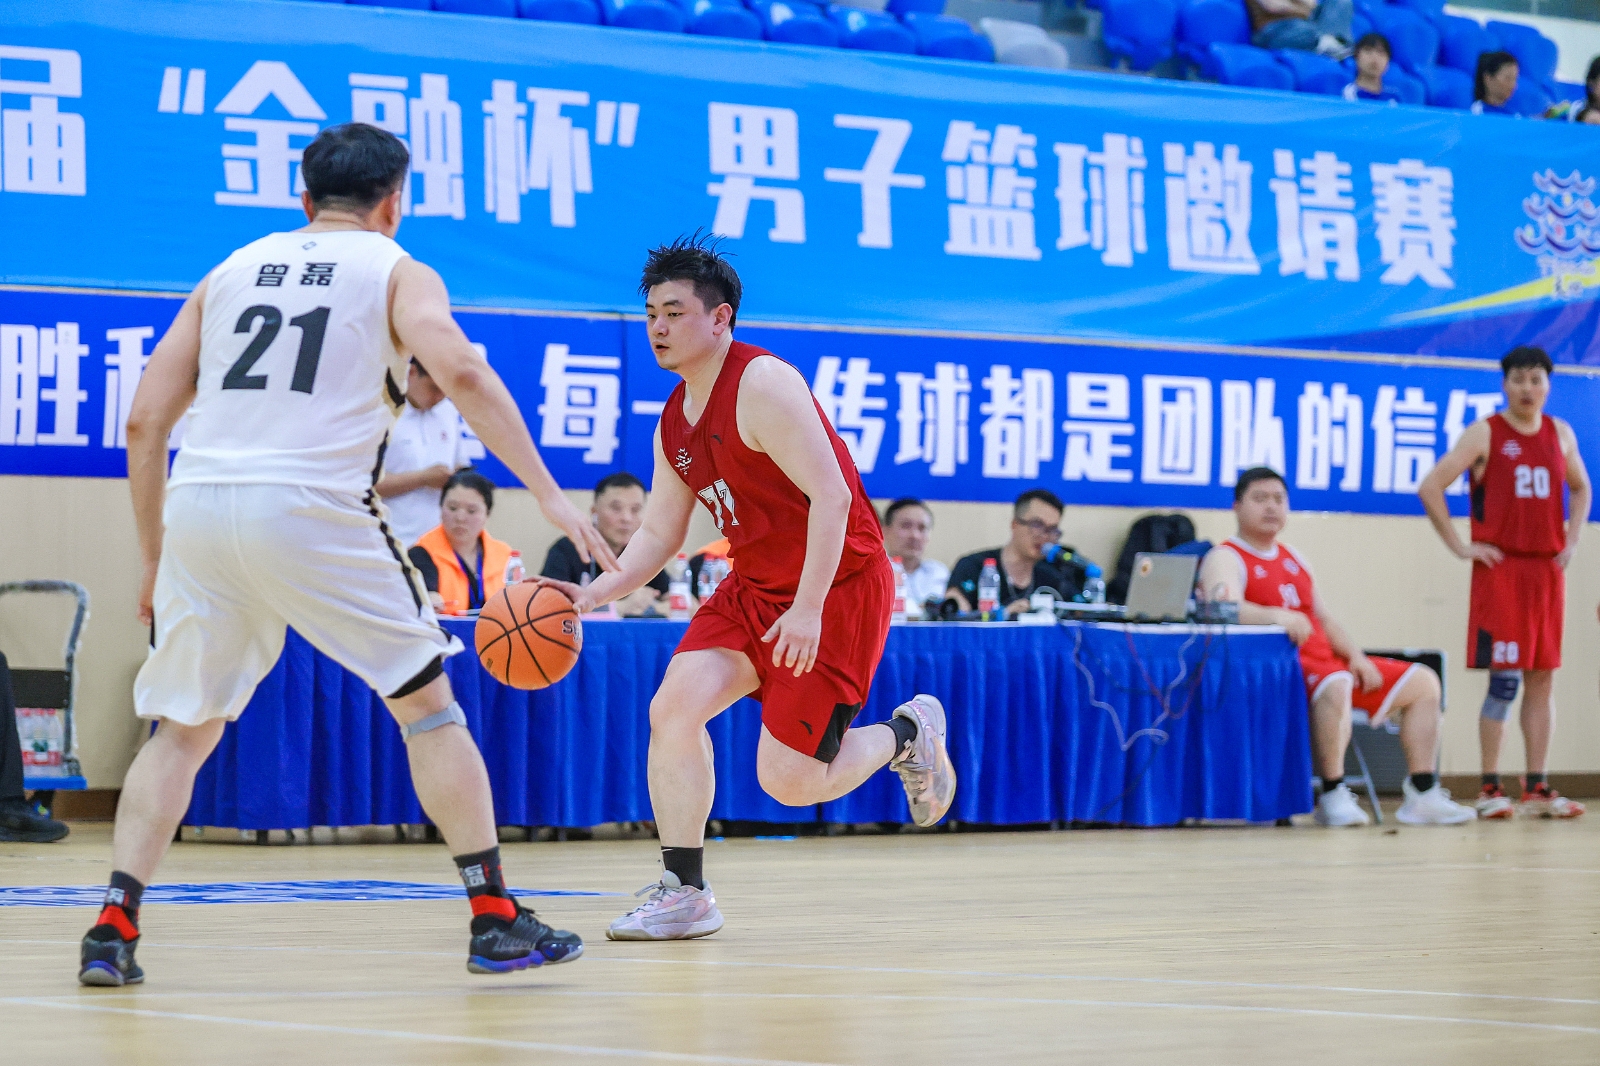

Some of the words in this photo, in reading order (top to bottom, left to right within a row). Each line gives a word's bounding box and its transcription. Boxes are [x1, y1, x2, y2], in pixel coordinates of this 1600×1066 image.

[255, 262, 338, 287] 曾磊
[221, 303, 331, 395] 21
[1514, 463, 1551, 500] 20
[697, 478, 740, 530] 77
